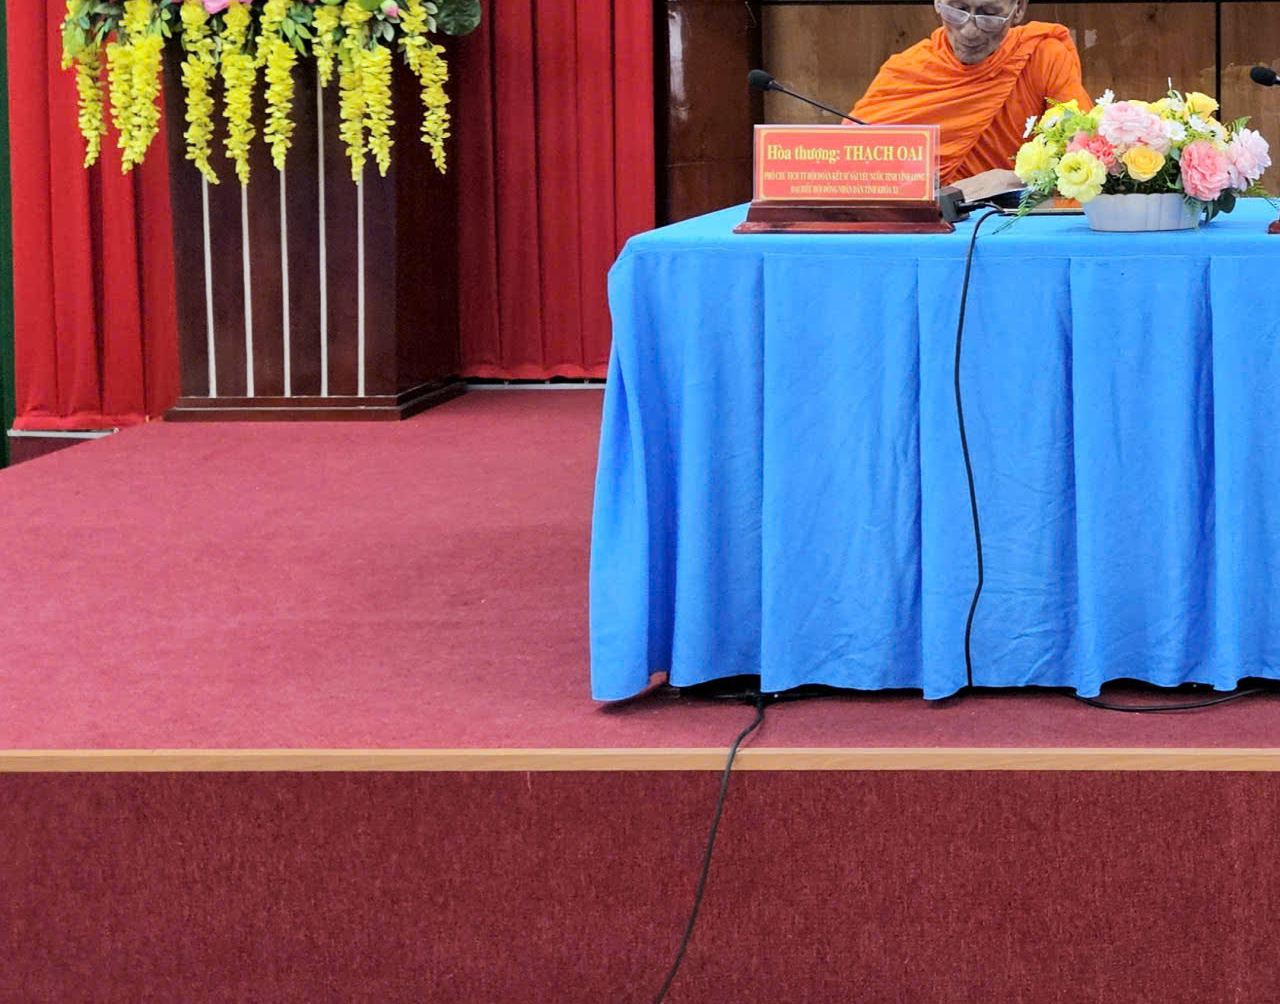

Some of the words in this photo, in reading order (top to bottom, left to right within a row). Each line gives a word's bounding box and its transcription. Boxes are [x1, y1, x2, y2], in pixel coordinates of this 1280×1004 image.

[767, 144, 791, 161] Hòa
[843, 145, 894, 164] THẠCH
[897, 145, 924, 161] OAI
